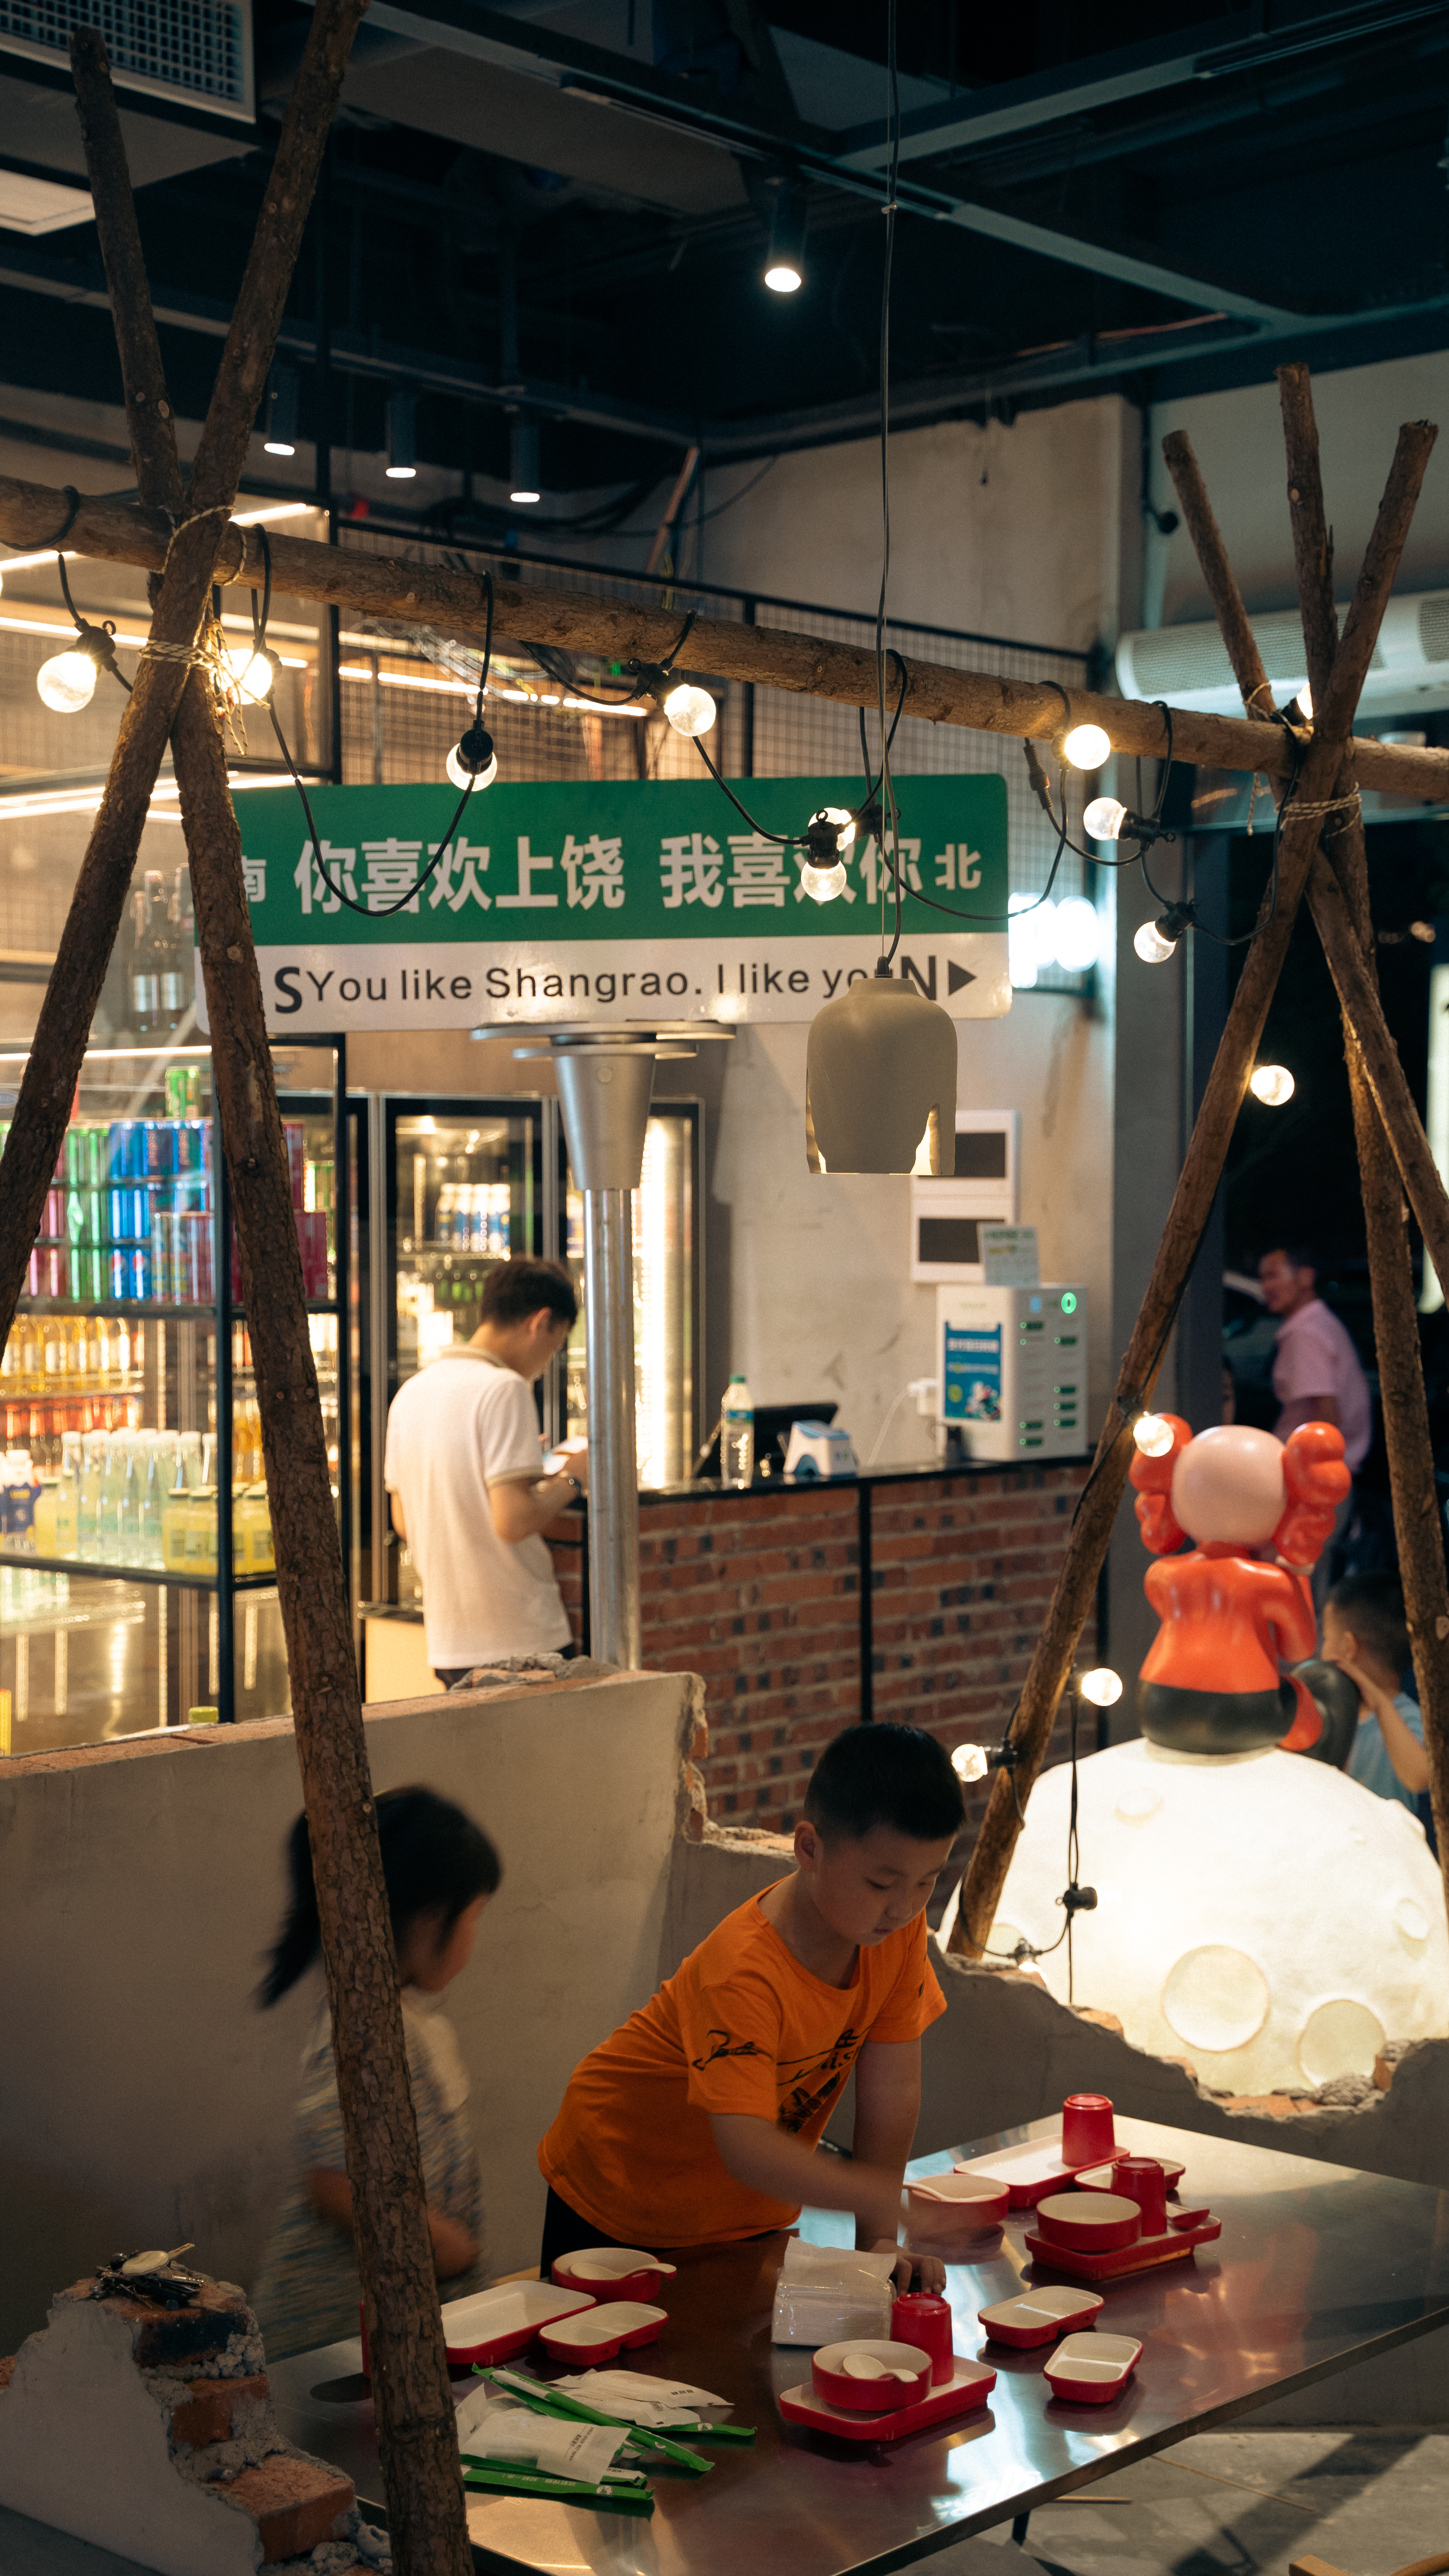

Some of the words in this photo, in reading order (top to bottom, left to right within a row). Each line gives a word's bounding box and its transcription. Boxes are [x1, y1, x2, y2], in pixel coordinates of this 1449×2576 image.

[294, 834, 625, 914] 你喜欢上饶
[934, 843, 982, 890] 北
[274, 966, 303, 1014] S
[306, 970, 386, 1001] You
[401, 969, 472, 999] like
[485, 967, 701, 1002] Shangrao.
[739, 963, 809, 993] like
[901, 955, 937, 1000] N
